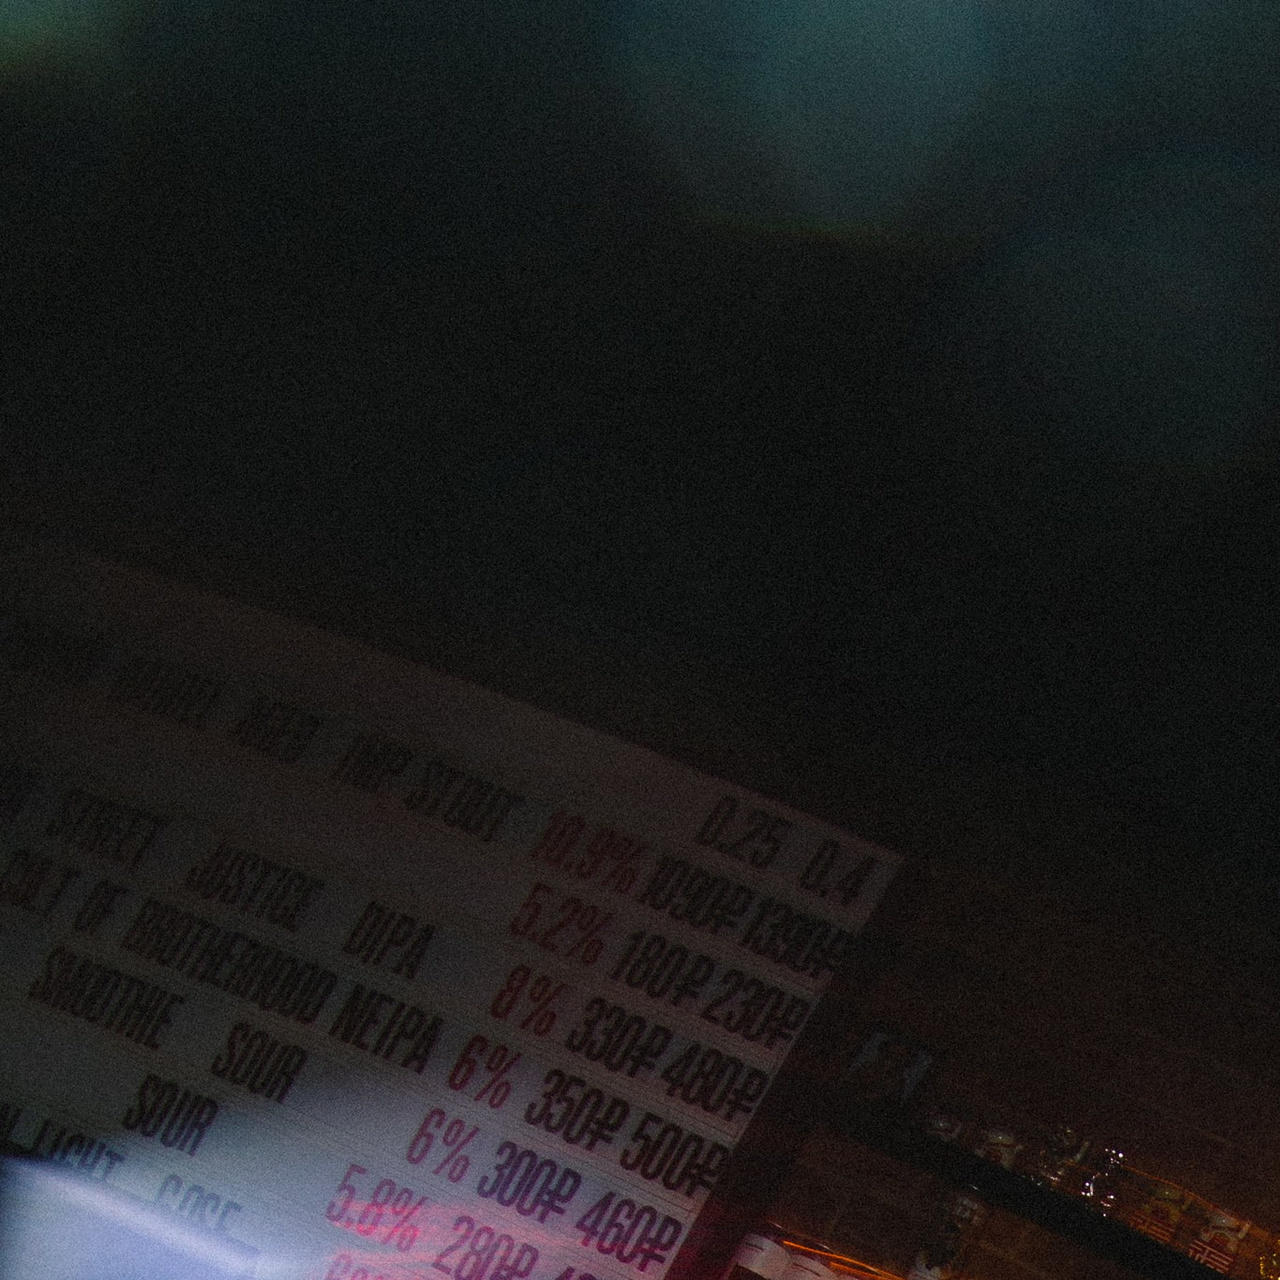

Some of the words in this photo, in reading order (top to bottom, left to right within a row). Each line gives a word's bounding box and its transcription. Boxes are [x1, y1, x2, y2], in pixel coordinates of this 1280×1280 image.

[530, 808, 650, 894] 10.9%
[700, 796, 792, 869] 0.25
[800, 838, 878, 904] 0.4
[74, 880, 129, 935] OF
[123, 899, 338, 1025] BROTHERHOOD
[329, 982, 446, 1075] NEIPA
[448, 1034, 522, 1109] 6%
[524, 1068, 628, 1151] 350₽
[620, 1112, 731, 1197] 500₽
[187, 840, 324, 932] JUSTICE
[344, 901, 436, 980] DIPA
[493, 964, 567, 1037] 8%
[567, 998, 671, 1079] 330₽
[662, 1044, 769, 1123] 480₽
[510, 882, 612, 966] 5.2%
[612, 929, 716, 1007] 180₽
[701, 968, 808, 1050] 230₽
[29, 945, 185, 1050] SMOOTHIE
[210, 1021, 309, 1103] SOUR
[405, 1107, 480, 1183] 6%
[477, 1140, 582, 1224] 300₽
[576, 1191, 683, 1273] 460₽
[123, 1072, 219, 1157] SOUR
[325, 1163, 428, 1254] 5.8%
